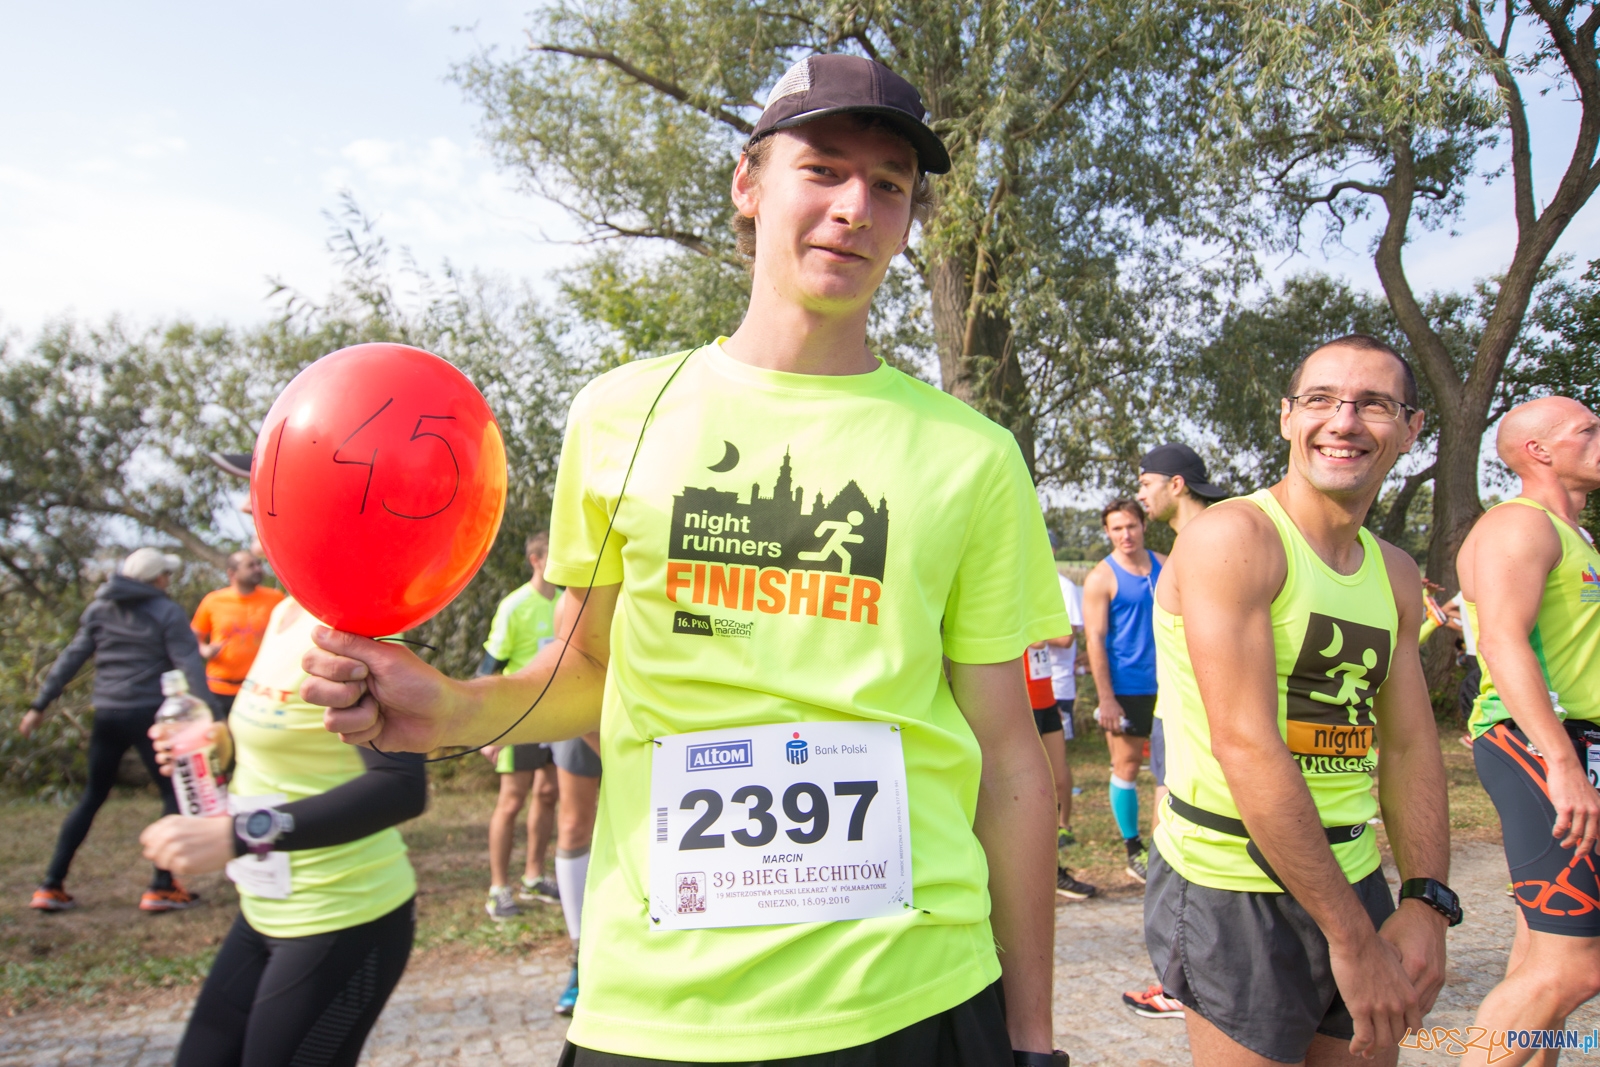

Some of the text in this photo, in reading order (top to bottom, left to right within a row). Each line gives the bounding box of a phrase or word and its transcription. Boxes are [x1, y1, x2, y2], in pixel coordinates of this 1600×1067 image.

[684, 509, 751, 535] night
[682, 534, 782, 558] runners
[666, 561, 882, 626] FINISHER
[691, 618, 709, 630] PKO
[715, 627, 752, 637] maraton
[814, 744, 868, 755] Bank Polski
[1314, 726, 1367, 755] night
[678, 780, 879, 850] 2397
[762, 853, 804, 865] MARCIN
[713, 860, 889, 890] 39 BIEG LECHITÓW
[725, 889, 772, 899] MISTRZOSTWA
[773, 888, 798, 896] POLSKI
[798, 886, 830, 895] LEKARZY
[831, 885, 838, 893] W
[757, 896, 850, 909] GNIEZNO, 18.09.2016
